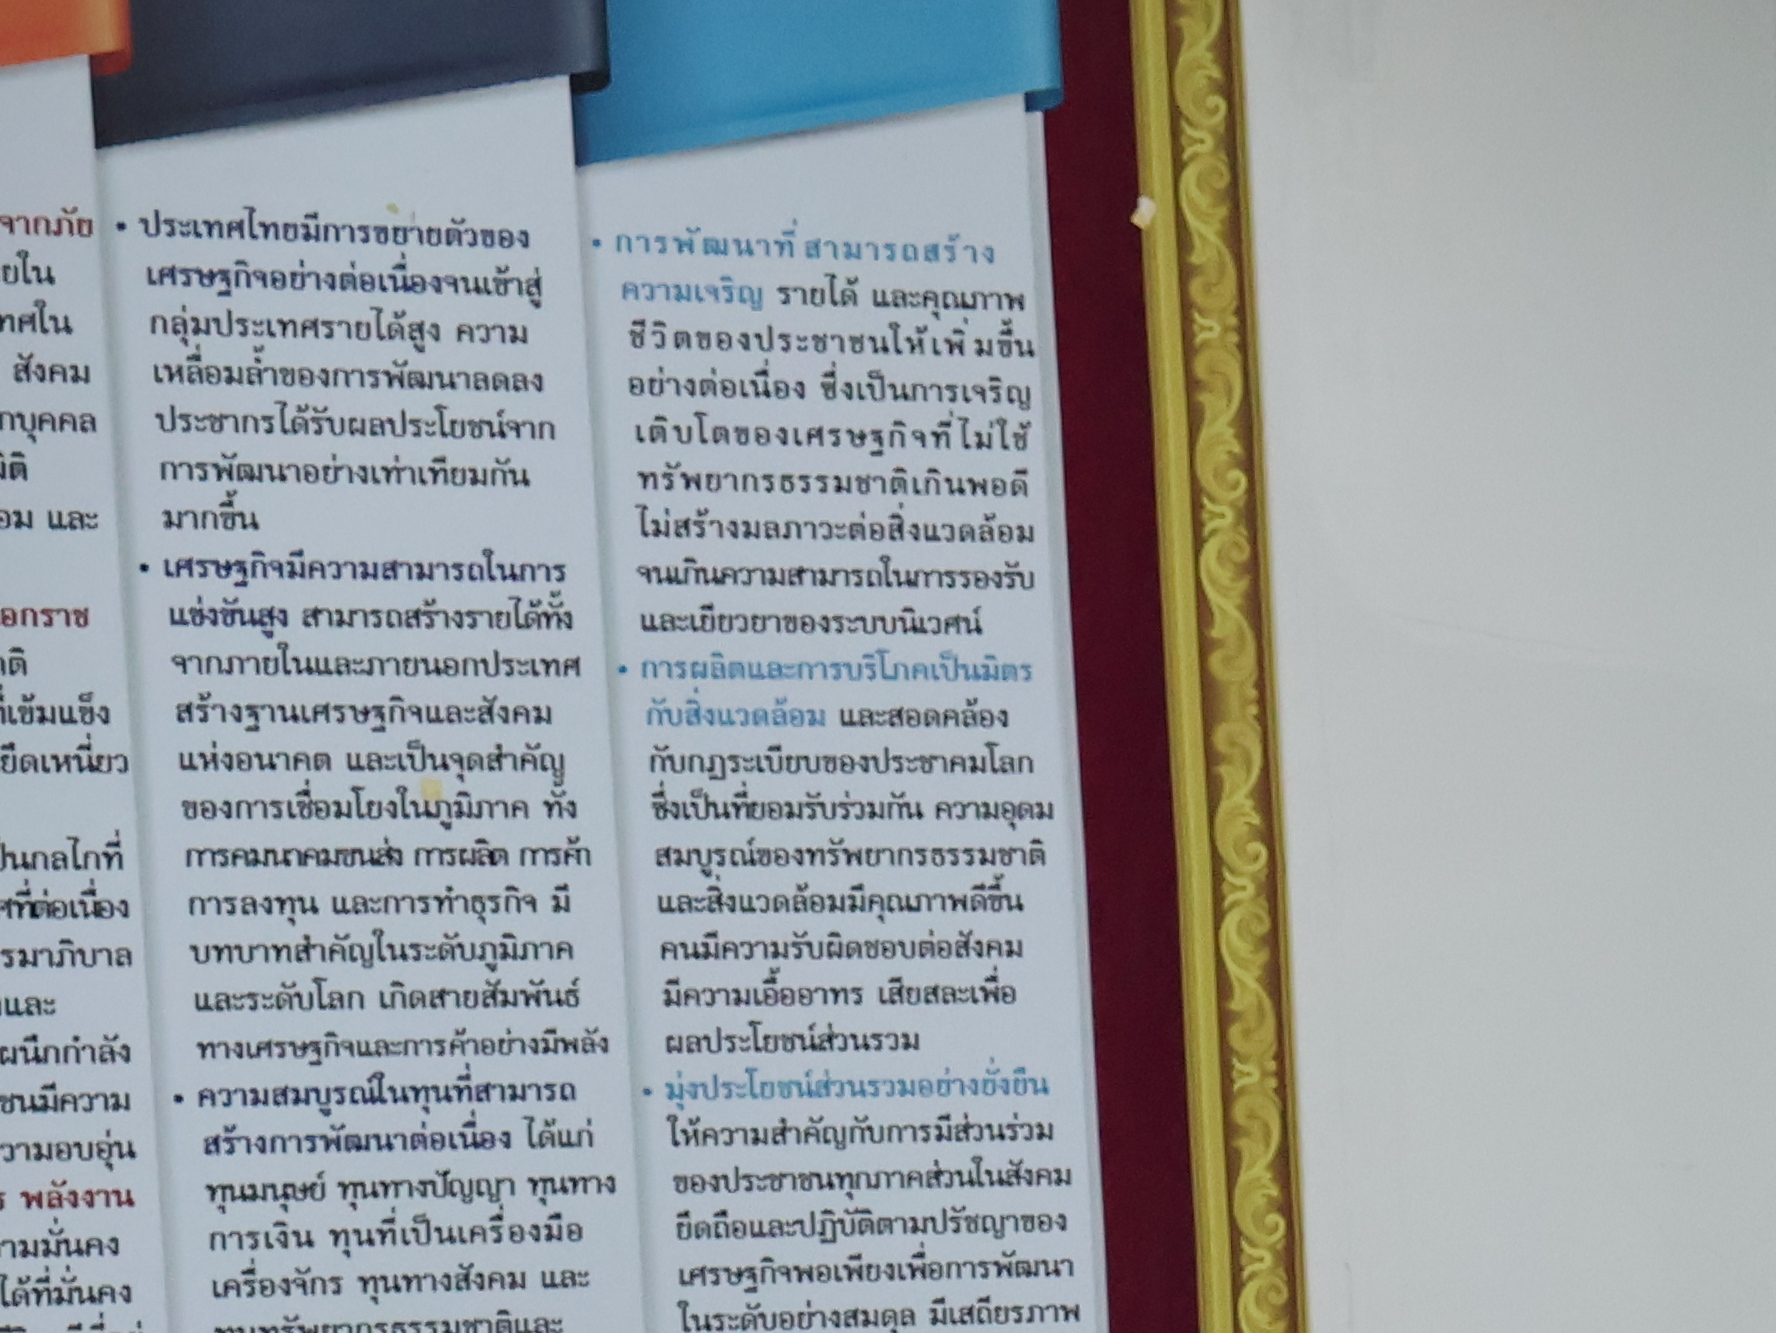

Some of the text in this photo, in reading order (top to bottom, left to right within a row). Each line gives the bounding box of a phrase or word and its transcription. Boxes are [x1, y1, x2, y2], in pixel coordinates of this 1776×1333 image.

[147, 254, 542, 308] เศรษฐกิจอย่างต่อเนื่องจนเข้าสู่
[622, 274, 1025, 320] ความเจริญ รายได้ และคุณภาพ
[150, 305, 528, 352] กลุ่มประเทศรายได้สูง ความ
[13, 352, 91, 384] สังคม
[154, 345, 543, 392] เหลื่อมล้ำของการพัฒนาลดลง
[628, 359, 805, 400] อย่างต่อเนื่อง
[155, 400, 555, 440] ประชากรได้รับผลประโยชน์จาก
[160, 452, 530, 487] การพัฒนาอย่างเท่าเทียมกัน
[637, 462, 1029, 497] ทรัพยากรธรรมชาติเกินพอดี
[47, 509, 98, 531] และ
[162, 490, 259, 531] มากขึ้น
[164, 549, 566, 587] เศรษฐกิจมีความสามารถในการ
[302, 591, 573, 631] สามารถสร้างรายได้ทั้ง
[171, 642, 581, 677] จากภายในและภายนอกประเทศ
[176, 691, 552, 732] สร้างฐานเศรษฐกิจและสังคม
[647, 687, 1009, 728] กับสิ่งแวดล้อม และสอดคล้อง
[179, 741, 331, 772] แห่งอนาคต
[542, 790, 577, 819] ทั้ง
[935, 801, 1054, 831] ความอุดม
[655, 838, 1045, 877] สมบูรณ์ของทรัพยากรธรรมชาติ
[189, 884, 570, 925] การลงทุน และการทำธุรกิจ มี
[190, 929, 573, 972] บทบาทสำคัญในระดับภูมิภาค
[661, 930, 1022, 960] คนมีความรับผิดชอบต่อสังคม
[195, 976, 580, 1011] และระดับโลก เกิดสายสัมพันธ์
[663, 966, 1016, 1007] มีความเอื้ออาทร เสียสละเพื่อ
[666, 1020, 920, 1054] ผลประโยชน์ส่วนรวม
[203, 1110, 593, 1156] สร้างการพัฒนาต่อเนื่อง ได้แก่
[667, 1113, 1053, 1150] ให้ความสำคัญกับการมีส่วนร่วม
[20, 1179, 135, 1210] พลังงาน
[528, 1173, 616, 1206] ทุนทาง
[209, 1206, 583, 1257] การเงิน ทุนที่เป็นเครื่องมือ
[212, 1257, 590, 1304] เครื่องจักร ทุนทางสังคม และ
[929, 1298, 1081, 1326] มีเสถียรภาพ
